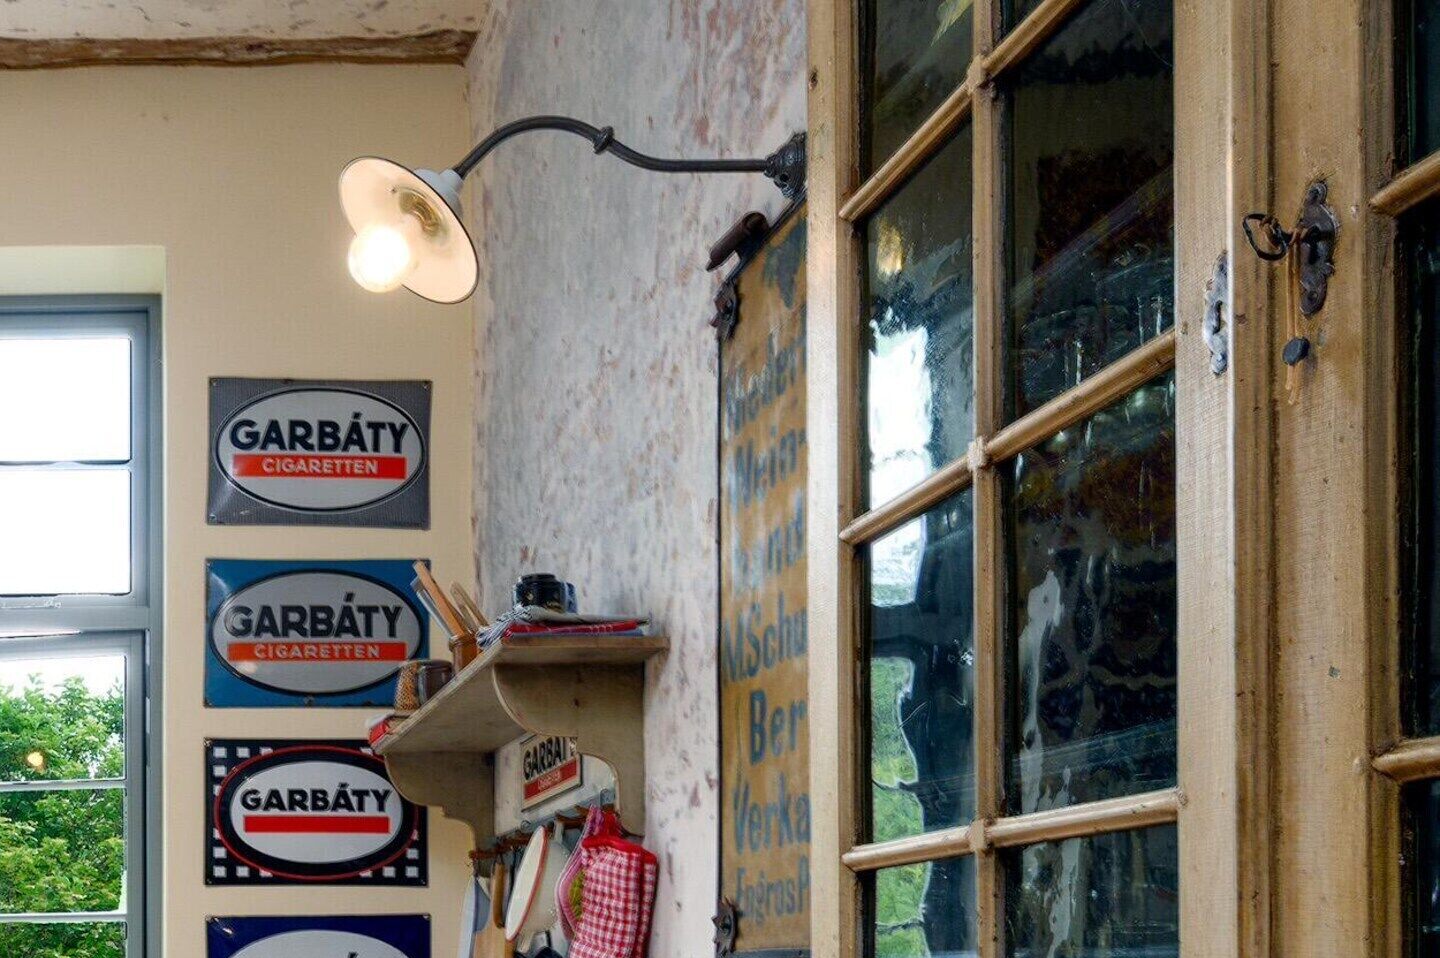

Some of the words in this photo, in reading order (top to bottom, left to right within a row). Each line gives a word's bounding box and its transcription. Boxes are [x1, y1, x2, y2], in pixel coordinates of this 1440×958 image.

[229, 412, 411, 454] GARBÁTY
[262, 458, 379, 475] CIGARETTEN
[224, 591, 404, 639] GARBÁTY
[254, 644, 381, 659] CIGARETTEN
[240, 782, 393, 813] GARBÁTY
